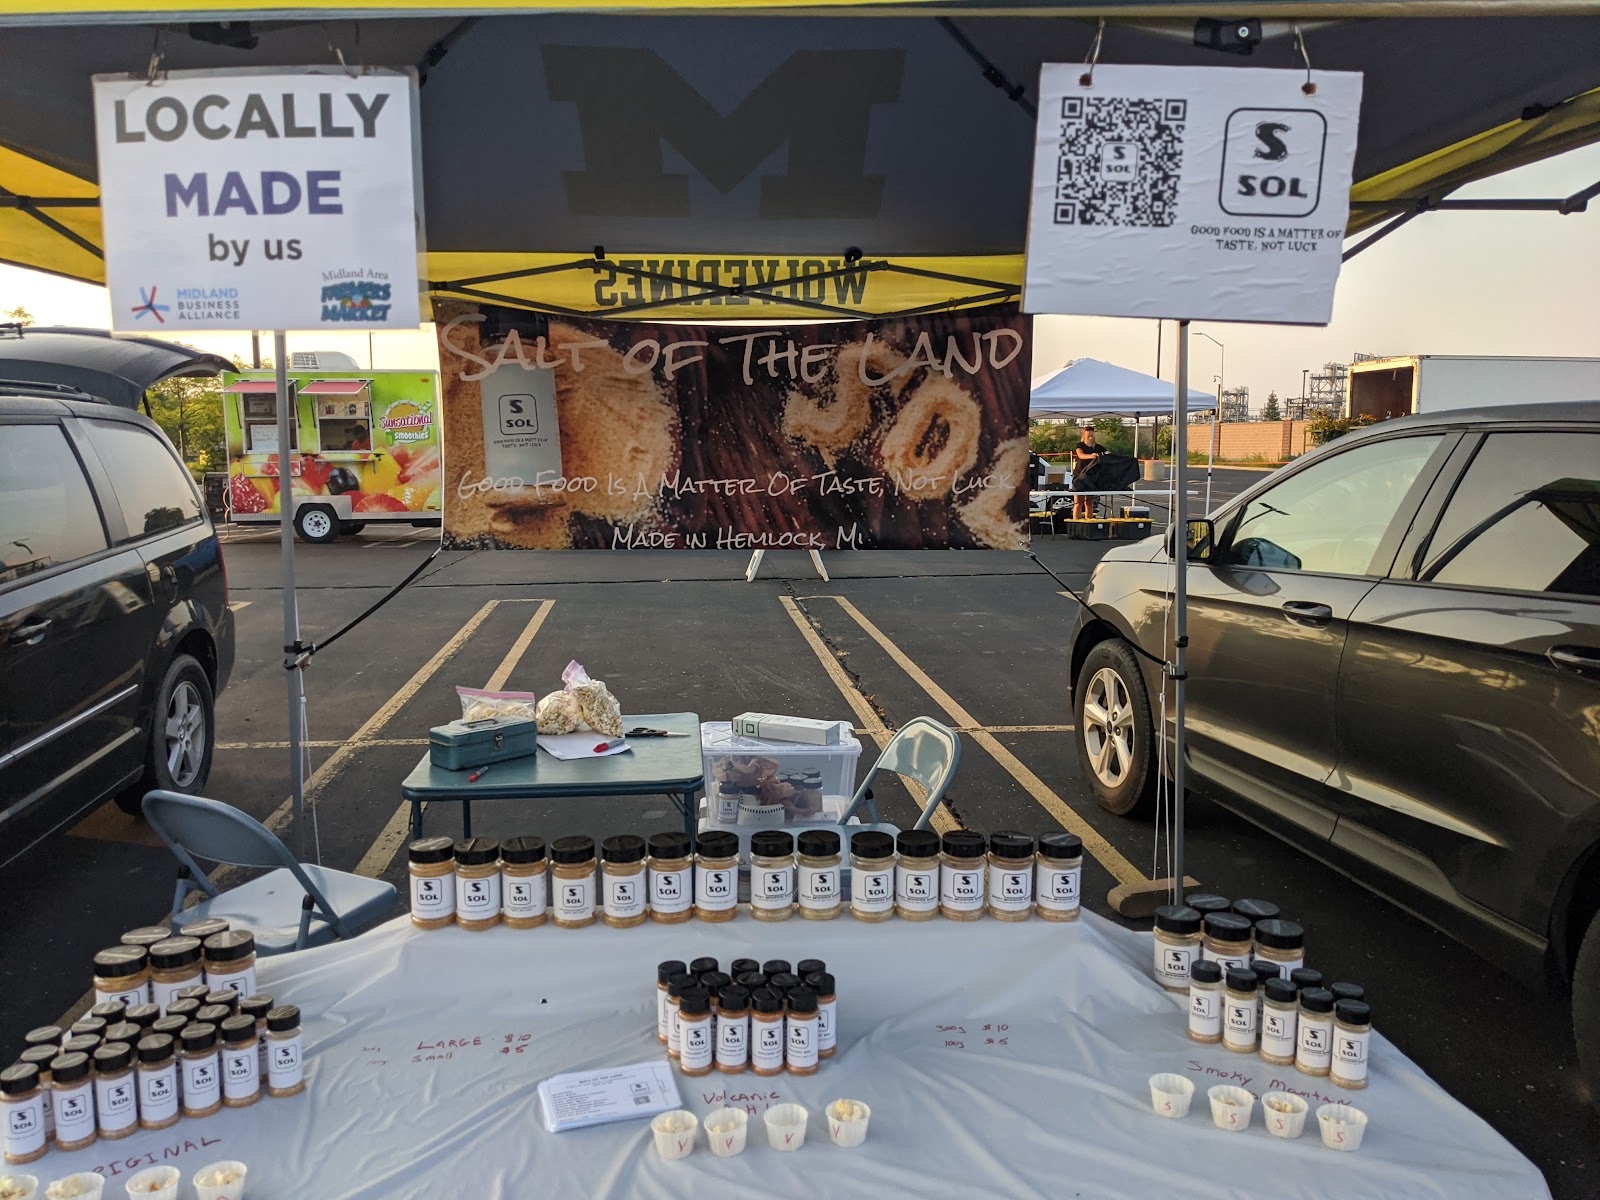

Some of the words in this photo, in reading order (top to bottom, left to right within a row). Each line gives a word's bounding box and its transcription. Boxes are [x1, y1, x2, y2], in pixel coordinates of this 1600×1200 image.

[114, 93, 390, 144] LOCALLY
[1253, 121, 1292, 162] S
[1106, 165, 1130, 173] SOL
[1237, 175, 1308, 198] SOL
[164, 170, 344, 218] MADE
[1191, 225, 1220, 236] GOOD
[1224, 226, 1250, 236] FOOD
[1254, 228, 1266, 238] IS
[1268, 228, 1274, 238] A
[1278, 228, 1324, 239] MATTER
[1327, 230, 1342, 238] OF
[208, 233, 250, 266] by
[264, 239, 302, 260] us
[1262, 242, 1284, 250] NOT
[1288, 242, 1317, 251] LUCK
[322, 268, 363, 281] Midland
[366, 268, 388, 280] Area
[176, 288, 238, 299] MIDLAND
[178, 300, 240, 310] BUSINESS
[178, 311, 240, 320] ALLIANCE
[441, 313, 609, 382] SALT
[622, 339, 709, 381] OF
[719, 331, 843, 385] THE
[858, 328, 1023, 386] LAND
[378, 412, 432, 430] Sunsational
[506, 418, 534, 428] SOL
[394, 430, 429, 440] smoothies
[458, 470, 524, 499] GOOD
[534, 470, 598, 496] FOOD
[633, 478, 652, 501] A
[658, 471, 764, 498] MATTER
[767, 471, 810, 498] OF
[895, 469, 947, 494] NOT
[950, 472, 1016, 494] LUCK
[612, 524, 678, 550] MADE
[686, 530, 707, 549] IN
[418, 1036, 482, 1050] LARGE
[1305, 1040, 1323, 1048] SOL
[195, 1076, 213, 1084] SOL
[152, 1089, 169, 1097] SOL
[112, 1097, 129, 1106] SOL
[14, 1122, 32, 1130] SOL
[92, 1136, 221, 1178] RIGINAL
